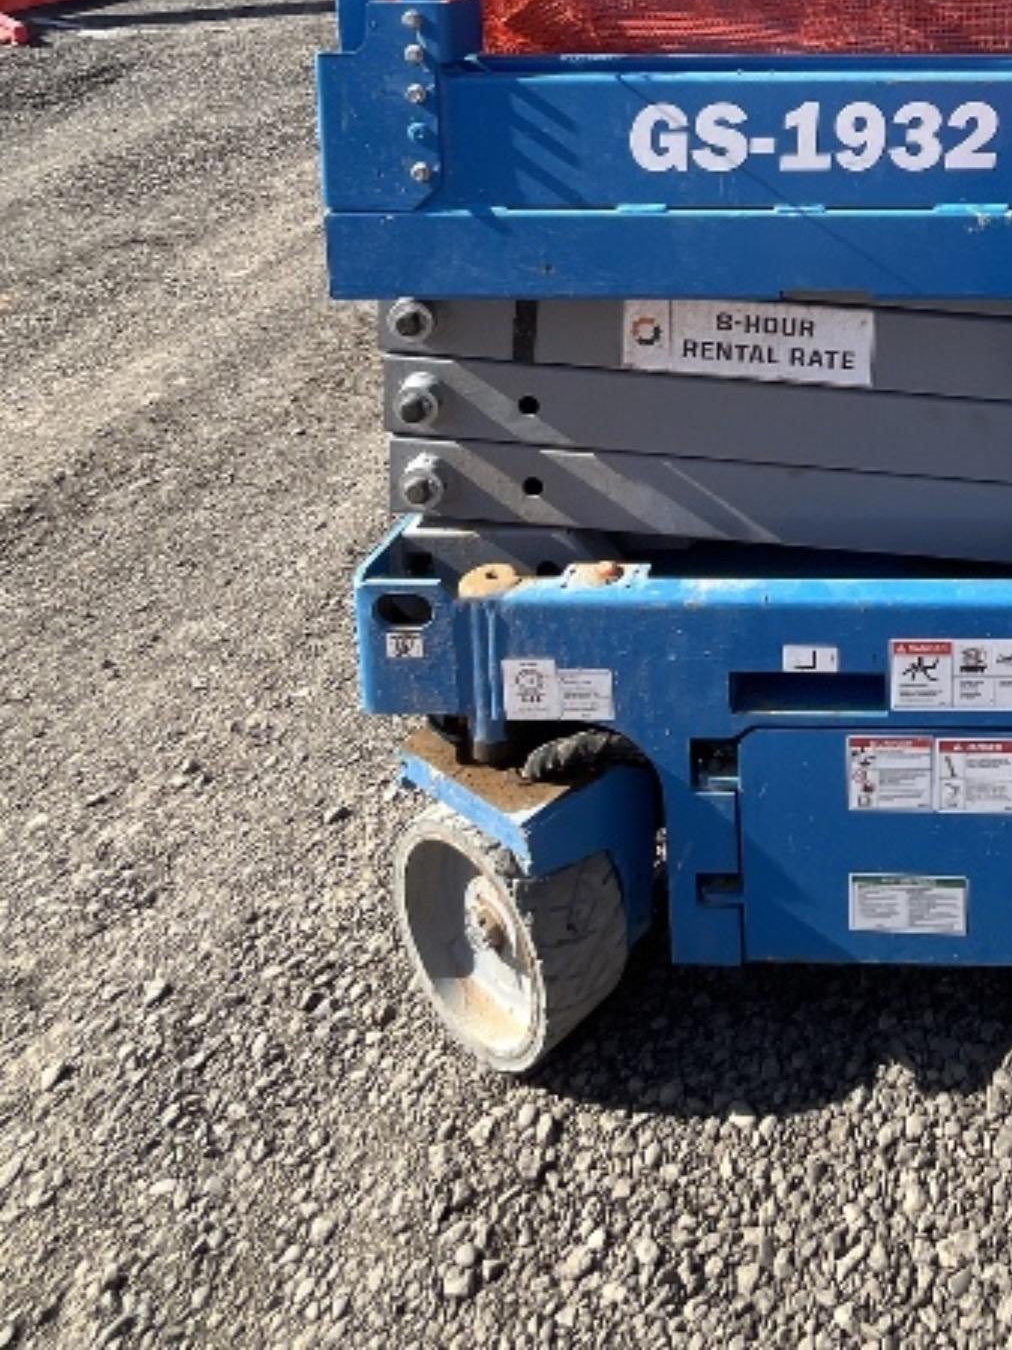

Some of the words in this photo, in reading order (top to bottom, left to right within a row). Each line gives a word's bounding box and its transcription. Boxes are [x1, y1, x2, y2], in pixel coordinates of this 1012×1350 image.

[629, 101, 999, 172] GS-1932
[716, 311, 815, 338] 8-HOUR
[683, 339, 779, 364] RENTAL
[789, 347, 855, 370] RATE
